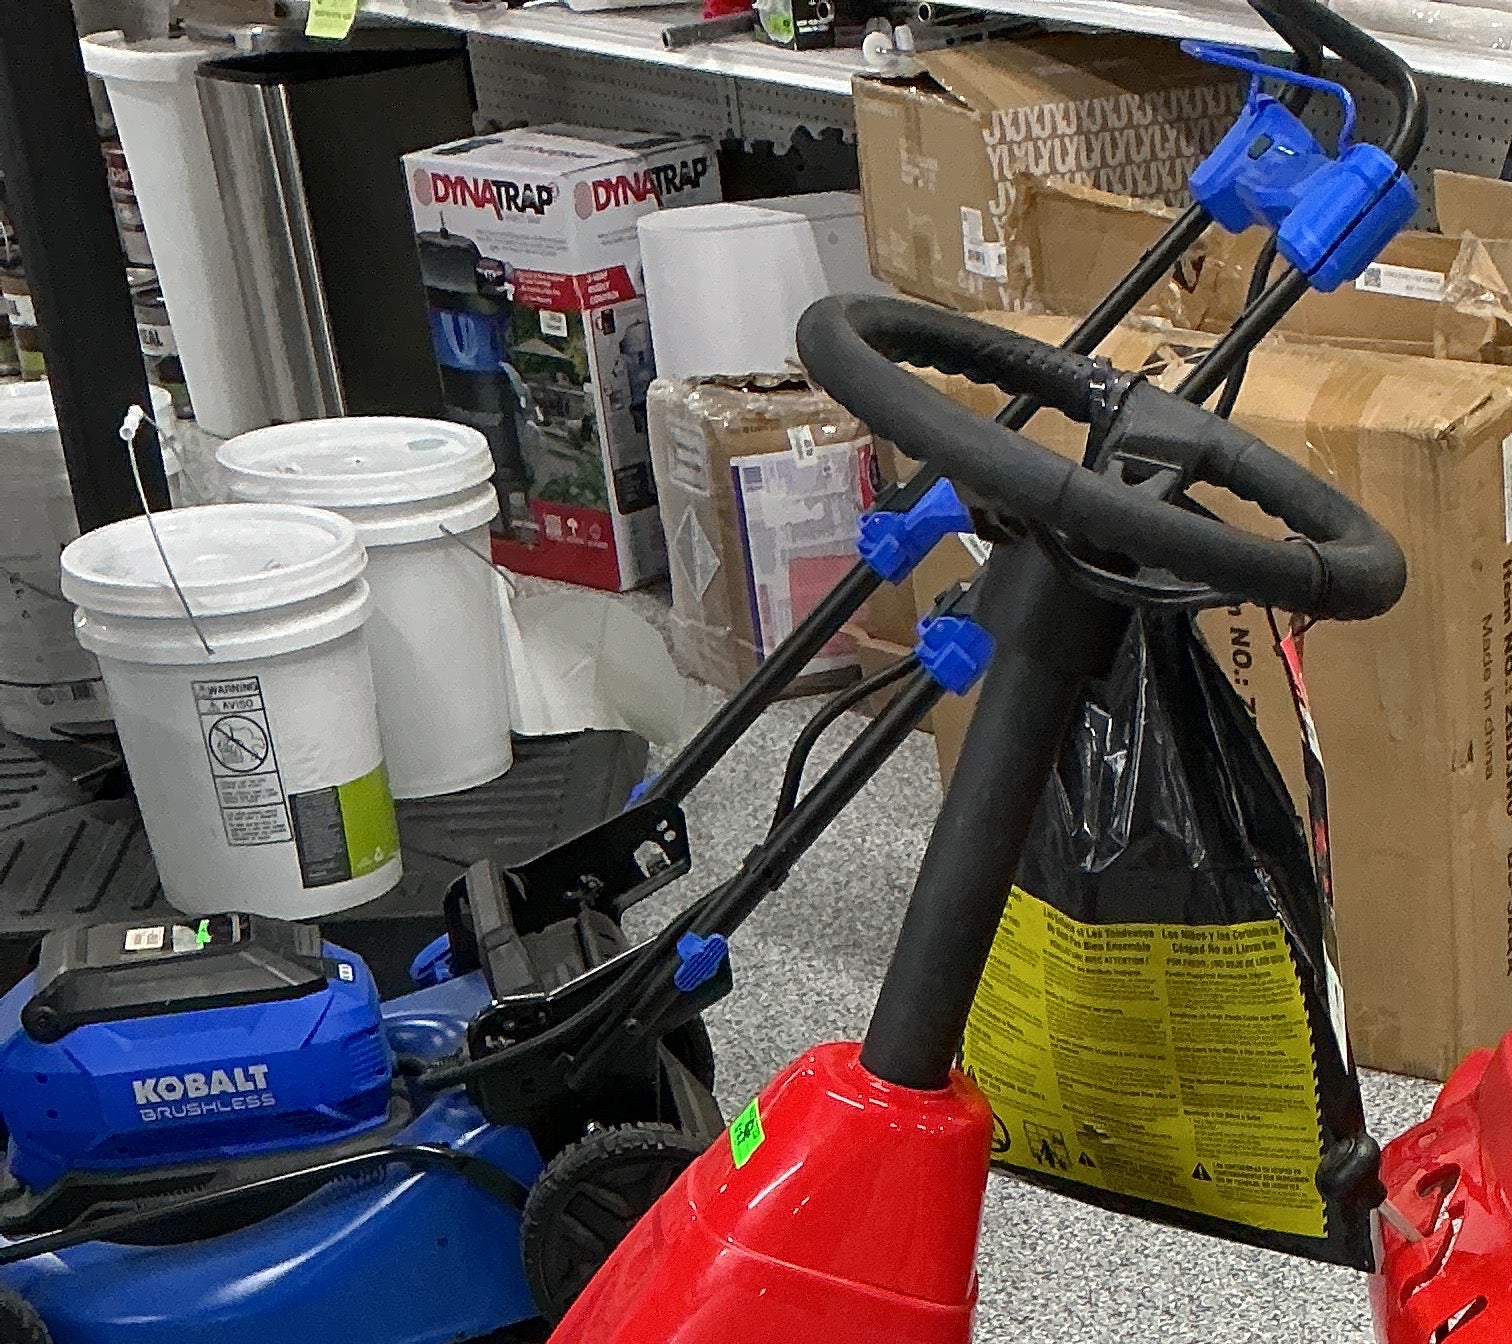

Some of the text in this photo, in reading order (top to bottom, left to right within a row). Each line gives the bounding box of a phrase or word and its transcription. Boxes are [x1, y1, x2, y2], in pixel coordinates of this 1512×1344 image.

[430, 171, 553, 220] DYNATRAP
[590, 156, 708, 208] DYNATRAP
[207, 681, 259, 696] WARNING
[222, 699, 254, 711] AVISO
[132, 1063, 269, 1105] KOBALT
[139, 1092, 277, 1122] BRUSHLESS
